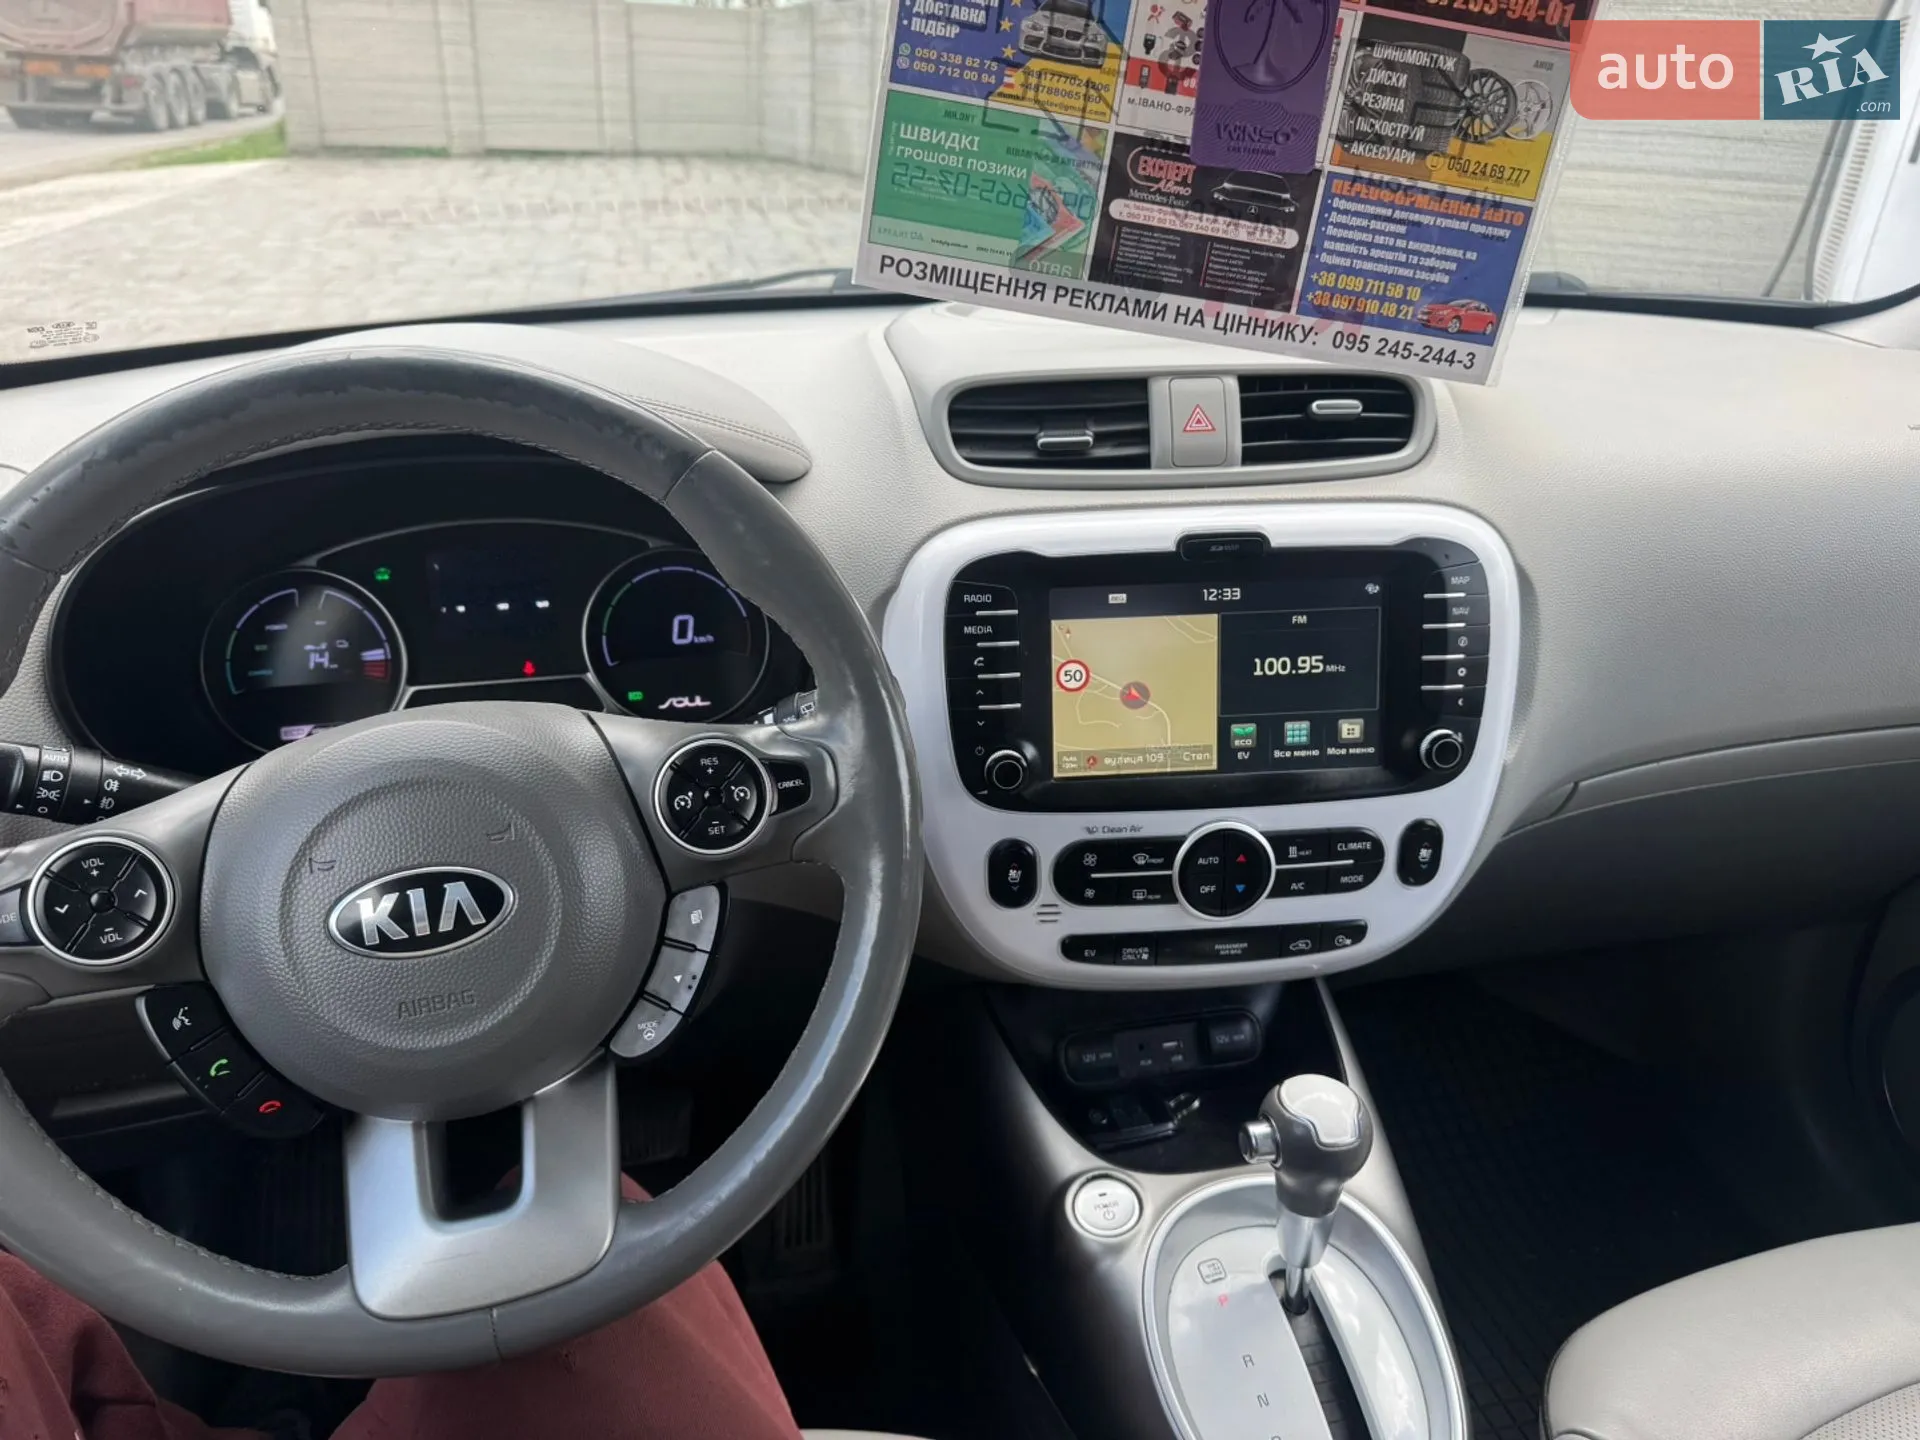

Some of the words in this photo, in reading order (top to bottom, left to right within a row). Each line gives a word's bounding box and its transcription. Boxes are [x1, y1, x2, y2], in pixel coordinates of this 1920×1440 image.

[912, 0, 987, 24] ДОСТАВКА
[911, 17, 960, 38] ПІДБІР
[914, 47, 937, 60] 050
[940, 52, 962, 65] 338
[1373, 43, 1457, 71] ШИНОМОНТАЖ
[913, 60, 935, 73] 050
[939, 65, 960, 78] 712
[963, 70, 978, 81] 00
[981, 74, 996, 85] 94
[1366, 68, 1408, 89] ДИСКИ
[1361, 92, 1405, 113] РЕЗИНА
[899, 123, 980, 151] ШВИДКІ
[1350, 141, 1415, 165] АКСЕСУАРИ
[896, 146, 964, 168] ГРОШОВІ
[967, 159, 1027, 179] ПОЗИКИ
[1447, 155, 1471, 174] 050
[1471, 160, 1488, 177] 24
[1507, 167, 1530, 184] 777
[1328, 211, 1407, 235] Довідки-рахунок
[1332, 197, 1393, 217] Оформлення
[1393, 209, 1435, 226] договору
[1436, 217, 1469, 231] купівлі
[1470, 223, 1511, 239] продажу
[1483, 207, 1524, 226] АВТО
[1326, 225, 1373, 243] Перевірка
[1373, 235, 1395, 247] авто
[1395, 238, 1407, 248] на
[1408, 254, 1419, 264] та
[1320, 252, 1351, 268] Оцінка
[1352, 258, 1414, 277] транспортних
[1414, 269, 1450, 284] засобів
[1311, 271, 1336, 288] +38
[1337, 274, 1364, 292] 099
[1365, 279, 1385, 296] 711
[1386, 282, 1405, 299] 58
[1406, 285, 1421, 301] 10
[1306, 290, 1331, 307] +38
[1332, 294, 1356, 310] 097
[1356, 297, 1380, 314] 910
[1380, 302, 1397, 317] 48
[1398, 305, 1414, 320] 21
[879, 254, 1046, 301] РОЗМІЩЕННЯ
[1055, 285, 1168, 318] РЕКЛАМИ
[1175, 304, 1205, 324] НА
[1213, 310, 1319, 346] ЦІННИКУ:
[1333, 331, 1371, 353] 095
[1375, 337, 1477, 370] 245-244-3
[1451, 576, 1470, 585] MAP
[964, 594, 992, 603] RADIO
[1202, 588, 1241, 601] 12:33
[1292, 615, 1307, 624] FM
[672, 614, 695, 645] 0
[693, 634, 715, 643] km/h
[964, 626, 993, 634] MEDIA
[309, 651, 329, 670] 14
[1253, 655, 1324, 676] 100.95
[1326, 664, 1346, 673] MHz
[1064, 669, 1083, 682] 50
[658, 696, 711, 709] SOUL
[1274, 749, 1292, 758] Все
[1294, 749, 1320, 757] меню
[1349, 746, 1375, 754] меню
[43, 753, 69, 763] AUTO
[701, 757, 719, 766] RES
[777, 778, 805, 789] CANCEL
[708, 825, 726, 835] SET
[1102, 825, 1127, 834] Clean
[1129, 824, 1143, 833] Air
[1337, 841, 1372, 851] CLIMATE
[81, 857, 105, 870] VOL
[1197, 856, 1219, 865] AUTO
[1340, 875, 1364, 884] MODE
[1200, 885, 1216, 894] OFF
[1290, 882, 1305, 891] A/C
[356, 881, 486, 946] KIA
[99, 931, 124, 944] VOL
[1084, 949, 1096, 957] EV
[1122, 947, 1149, 955] DRIVER
[398, 989, 475, 1020] AIRBAG
[638, 1020, 659, 1029] MODE
[1093, 1201, 1119, 1211] POWER
[1219, 1294, 1228, 1306] P
[1242, 1354, 1255, 1368] R
[1257, 1393, 1270, 1408] N
